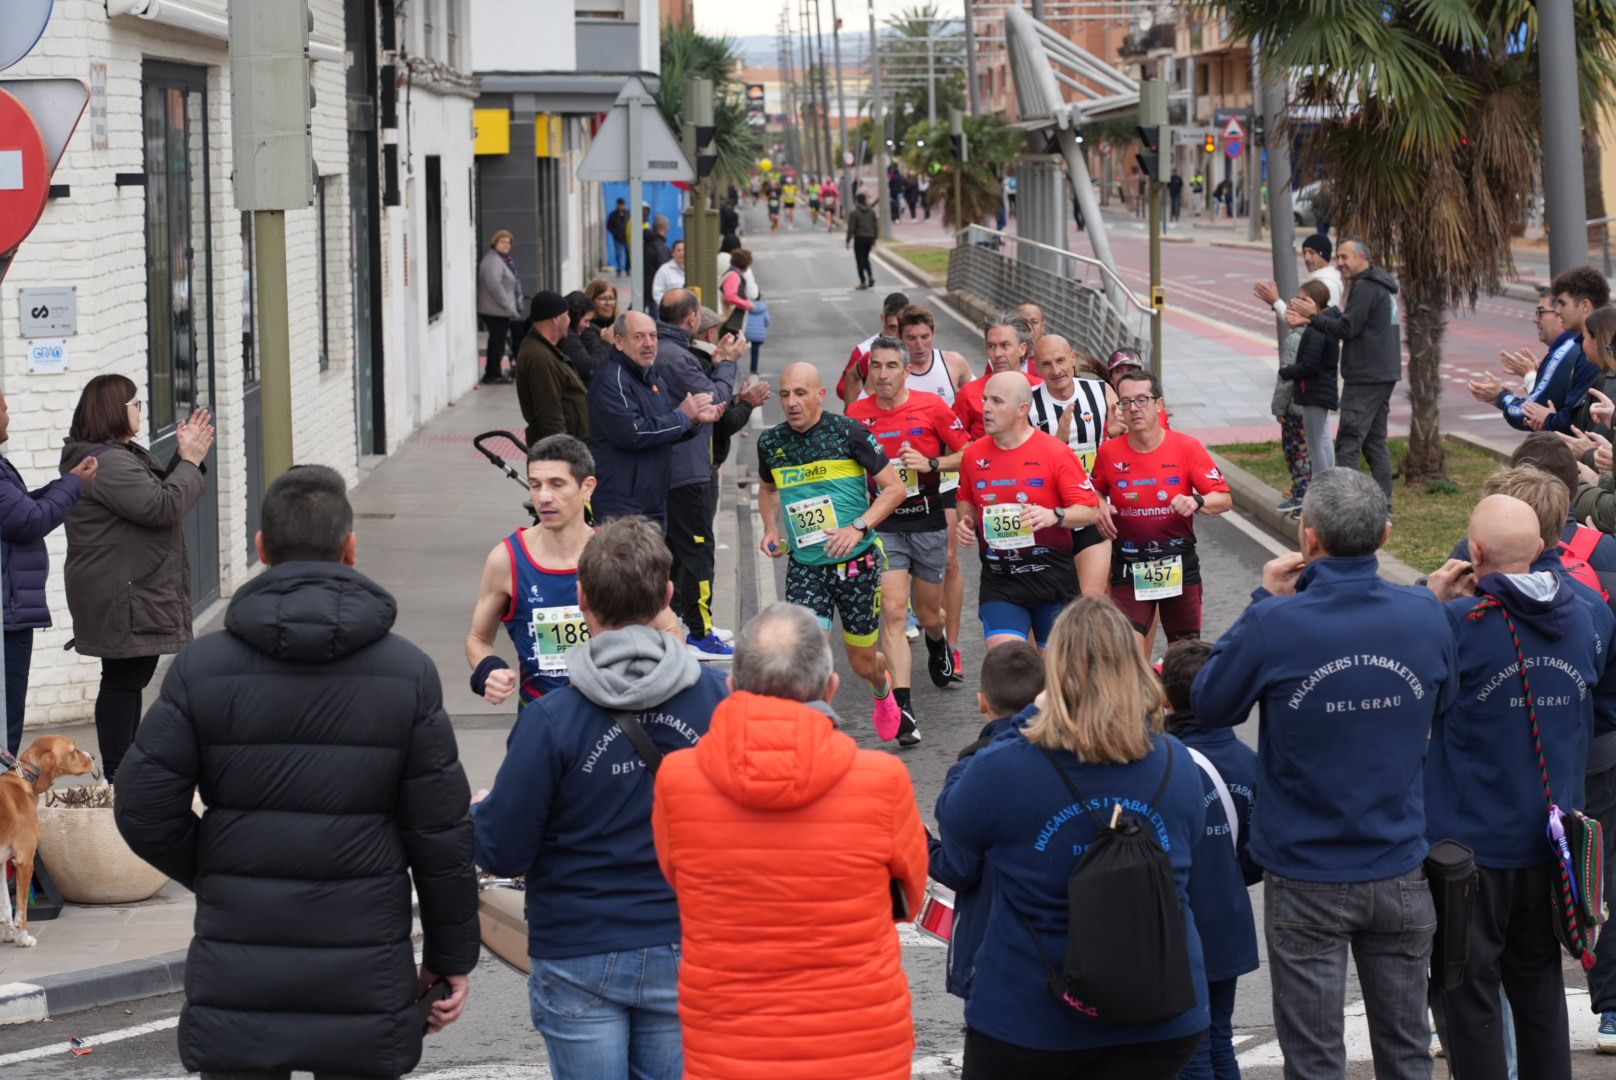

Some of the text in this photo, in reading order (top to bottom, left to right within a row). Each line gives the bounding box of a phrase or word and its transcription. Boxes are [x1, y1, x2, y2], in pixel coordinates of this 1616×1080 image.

[797, 508, 826, 529] 323
[993, 516, 1021, 532] 356
[1144, 567, 1172, 582] 457
[551, 622, 591, 645] 188
[1288, 654, 1425, 710] DOLÇAINERS I TABALETERS
[1326, 696, 1401, 713] DEL GRAU
[1509, 695, 1571, 707] DE GRAU
